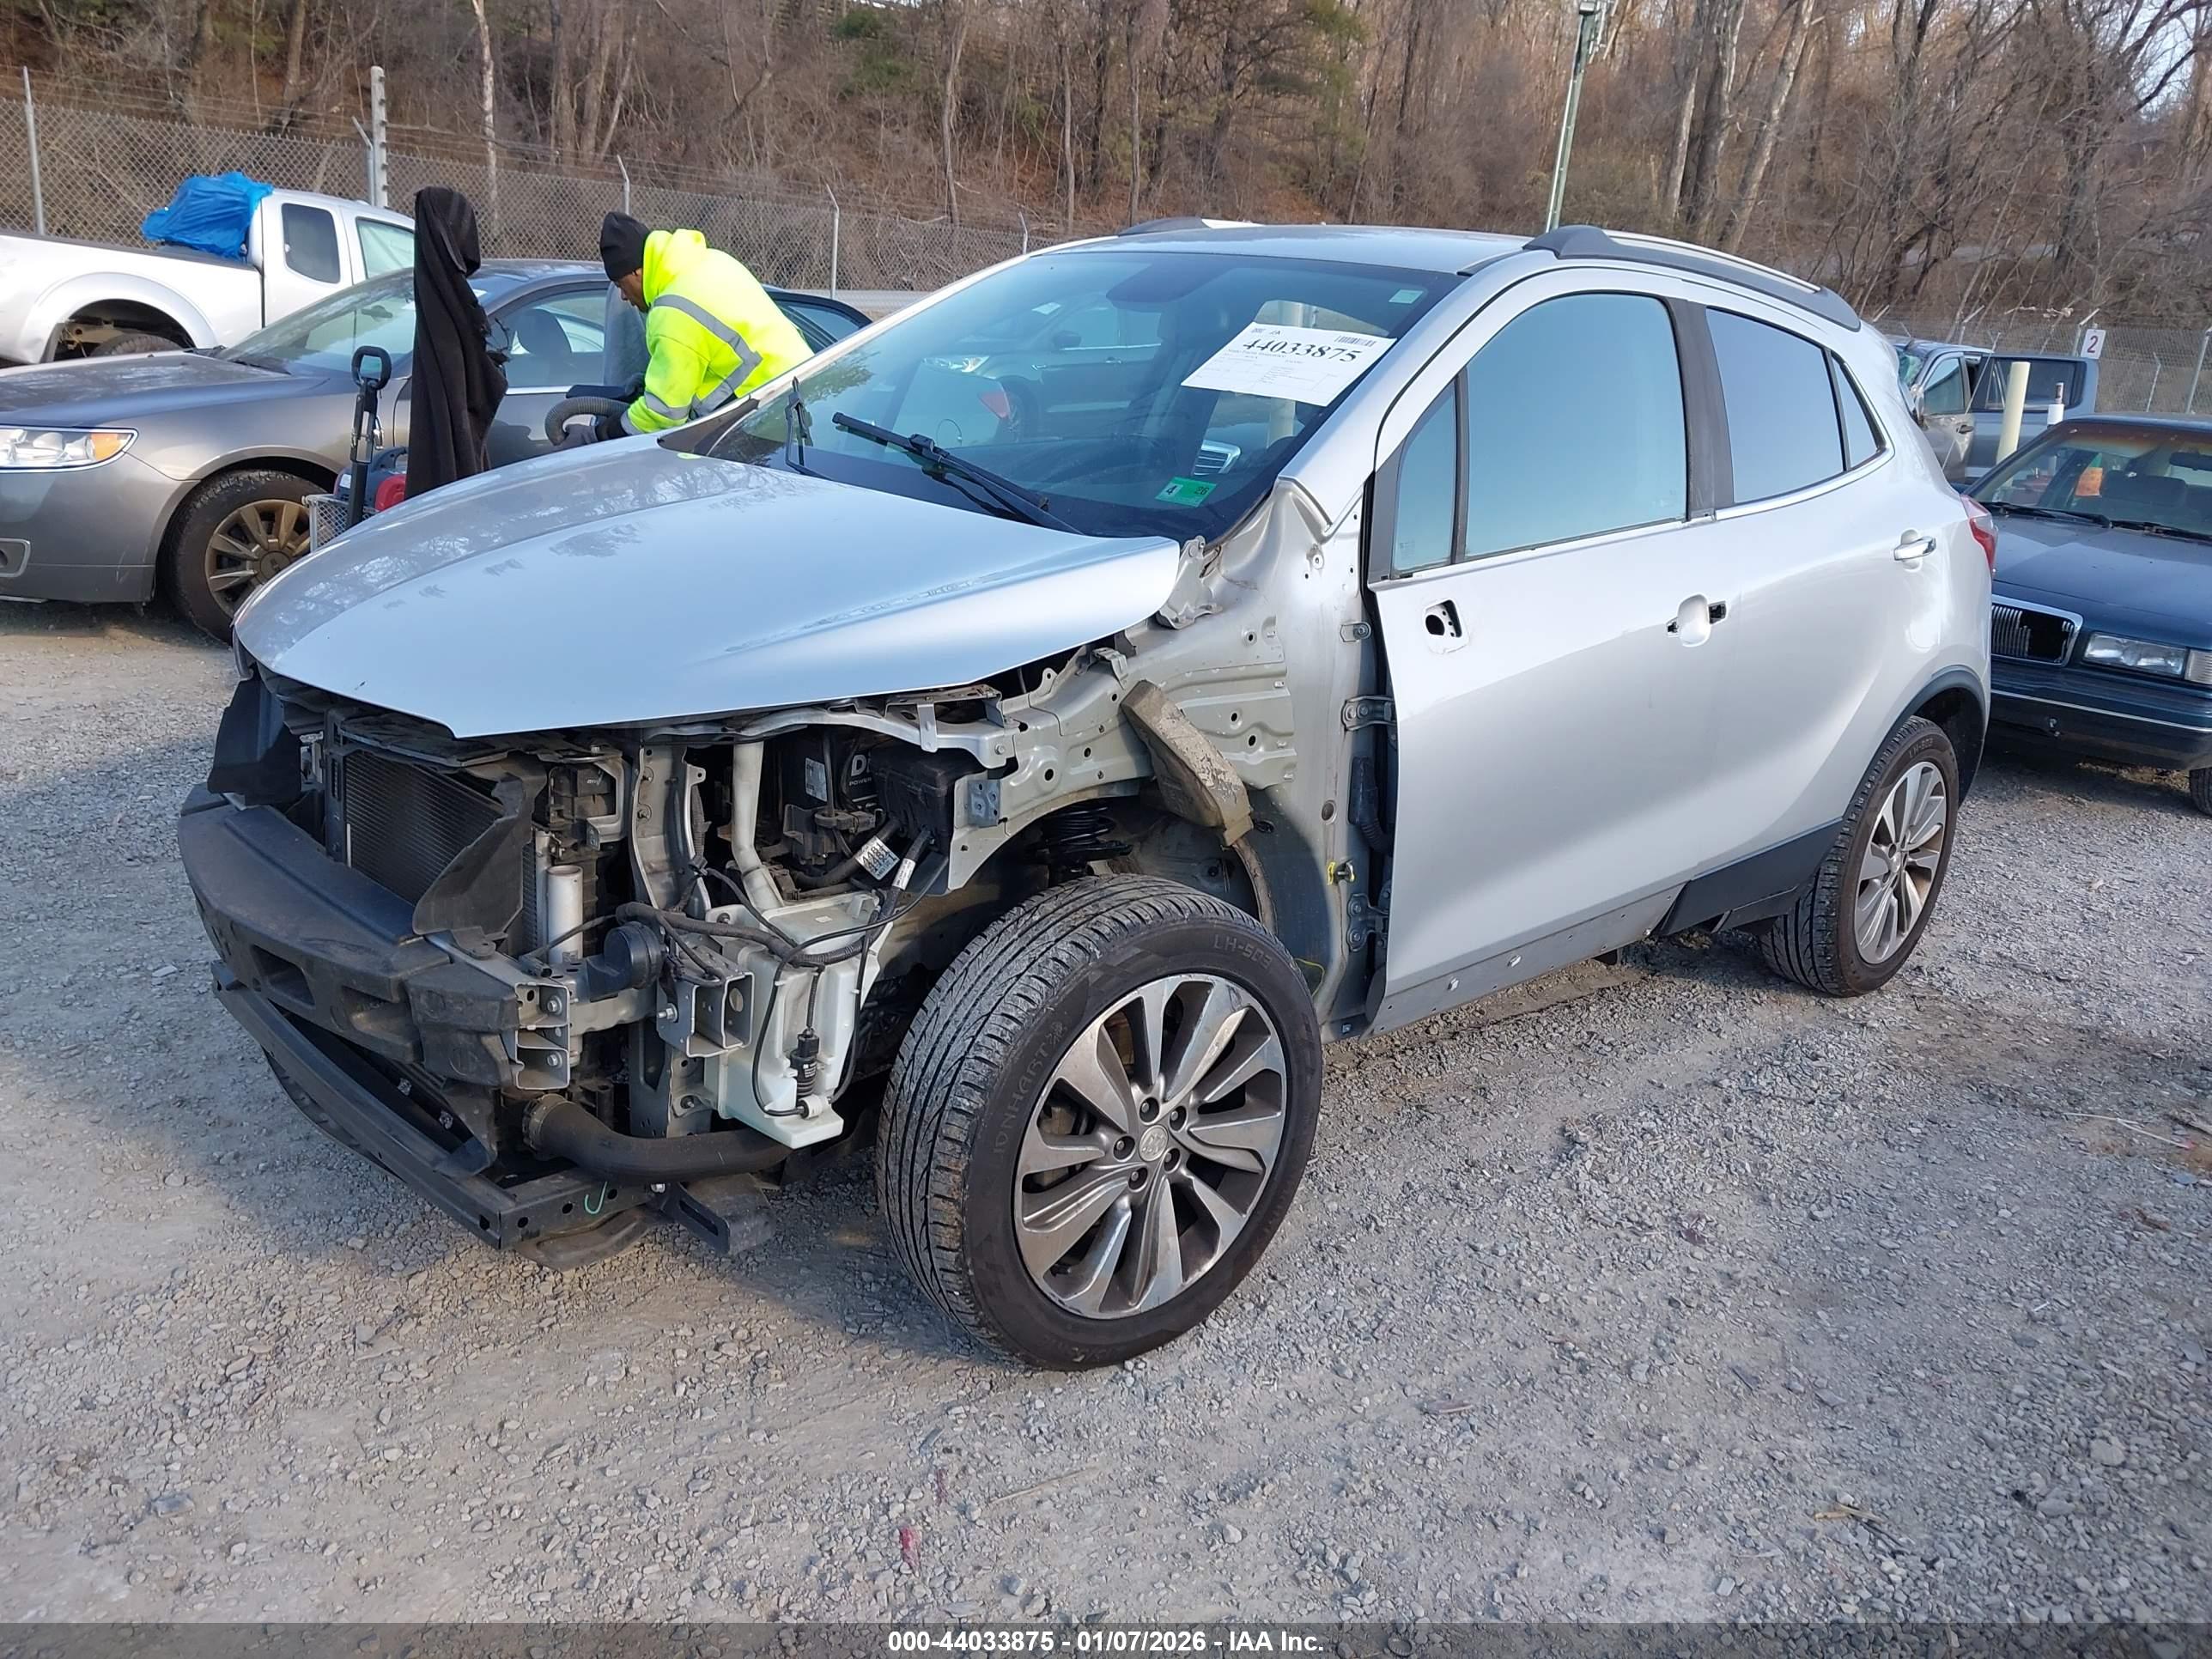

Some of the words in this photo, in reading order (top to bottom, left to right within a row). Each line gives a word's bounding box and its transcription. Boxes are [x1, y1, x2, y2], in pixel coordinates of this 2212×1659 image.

[1243, 338, 1362, 362] 44033875
[2087, 335, 2099, 353] 2
[1166, 485, 1177, 495] 4
